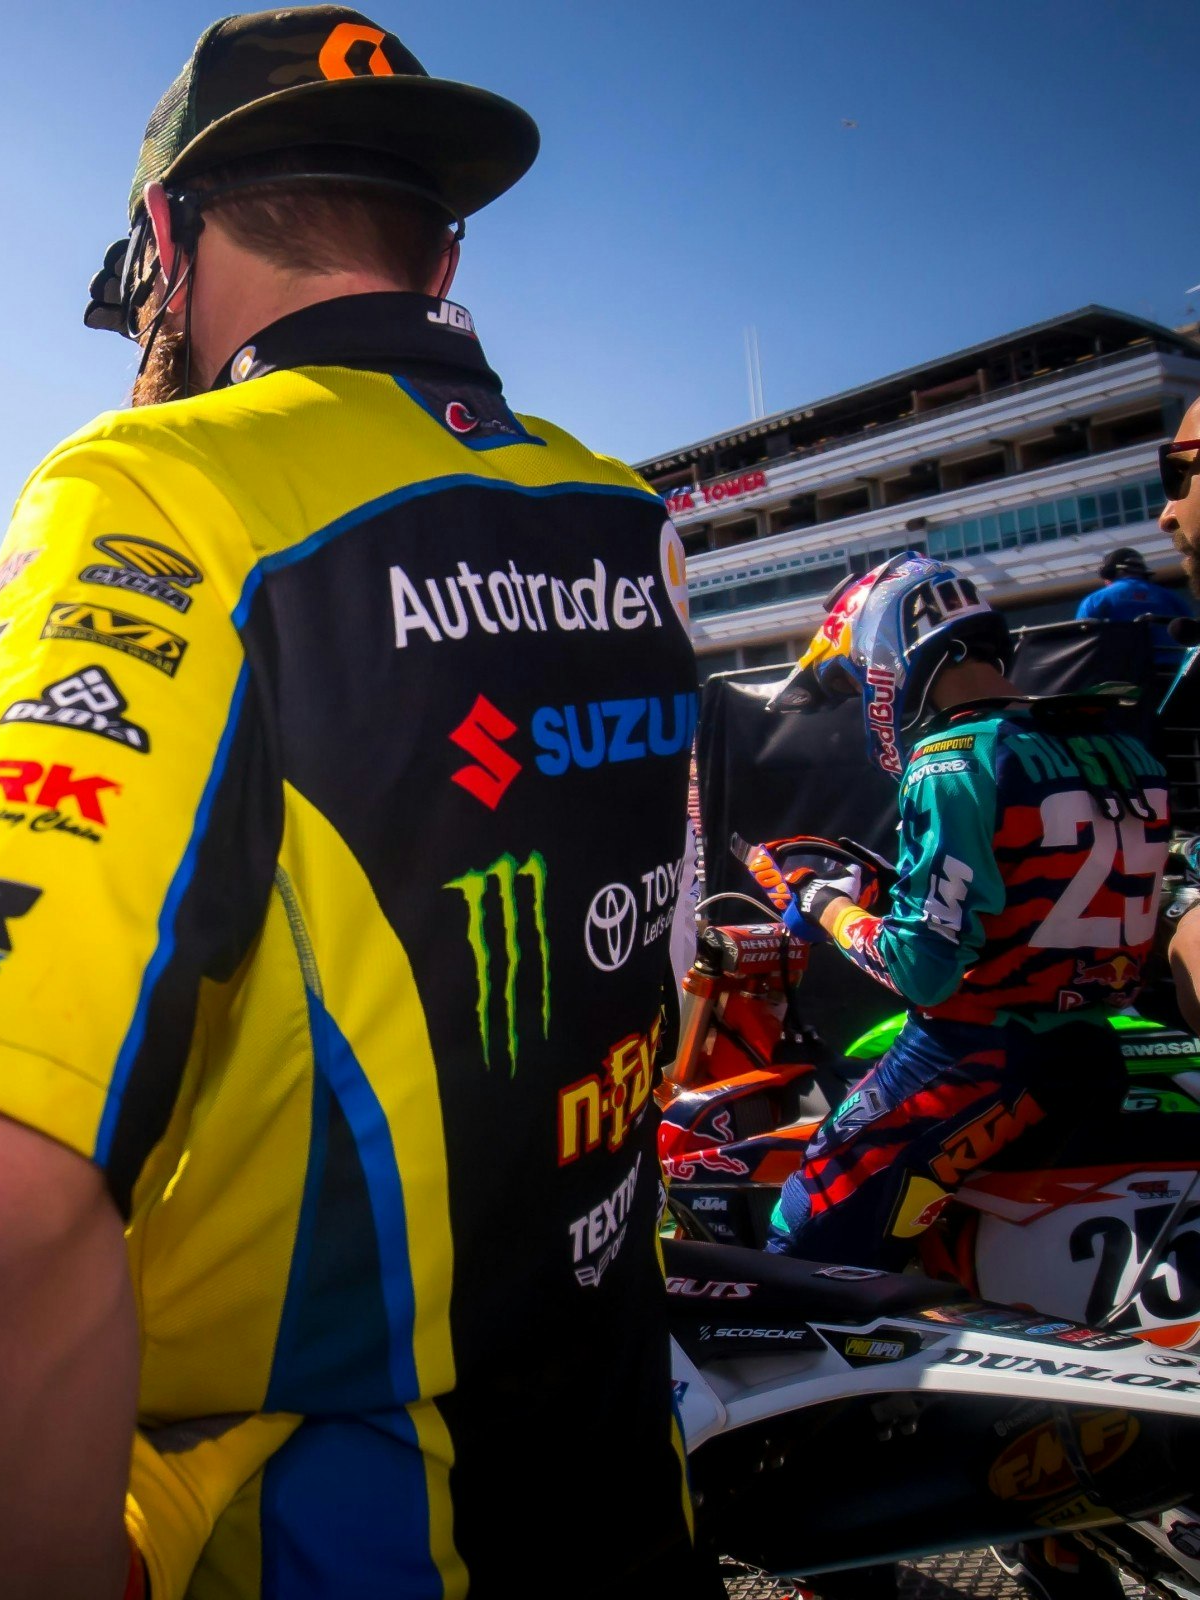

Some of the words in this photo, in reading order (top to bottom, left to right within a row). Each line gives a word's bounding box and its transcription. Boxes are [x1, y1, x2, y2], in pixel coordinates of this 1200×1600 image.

[701, 470, 767, 504] TOWER
[390, 559, 663, 649] Autotrader
[908, 759, 971, 787] MOTOREX
[1028, 788, 1169, 949] 25
[929, 1091, 1047, 1186] KTM
[692, 1196, 728, 1211] KTM
[666, 1276, 759, 1298] GUTS
[714, 1327, 808, 1340] SCOSCHE
